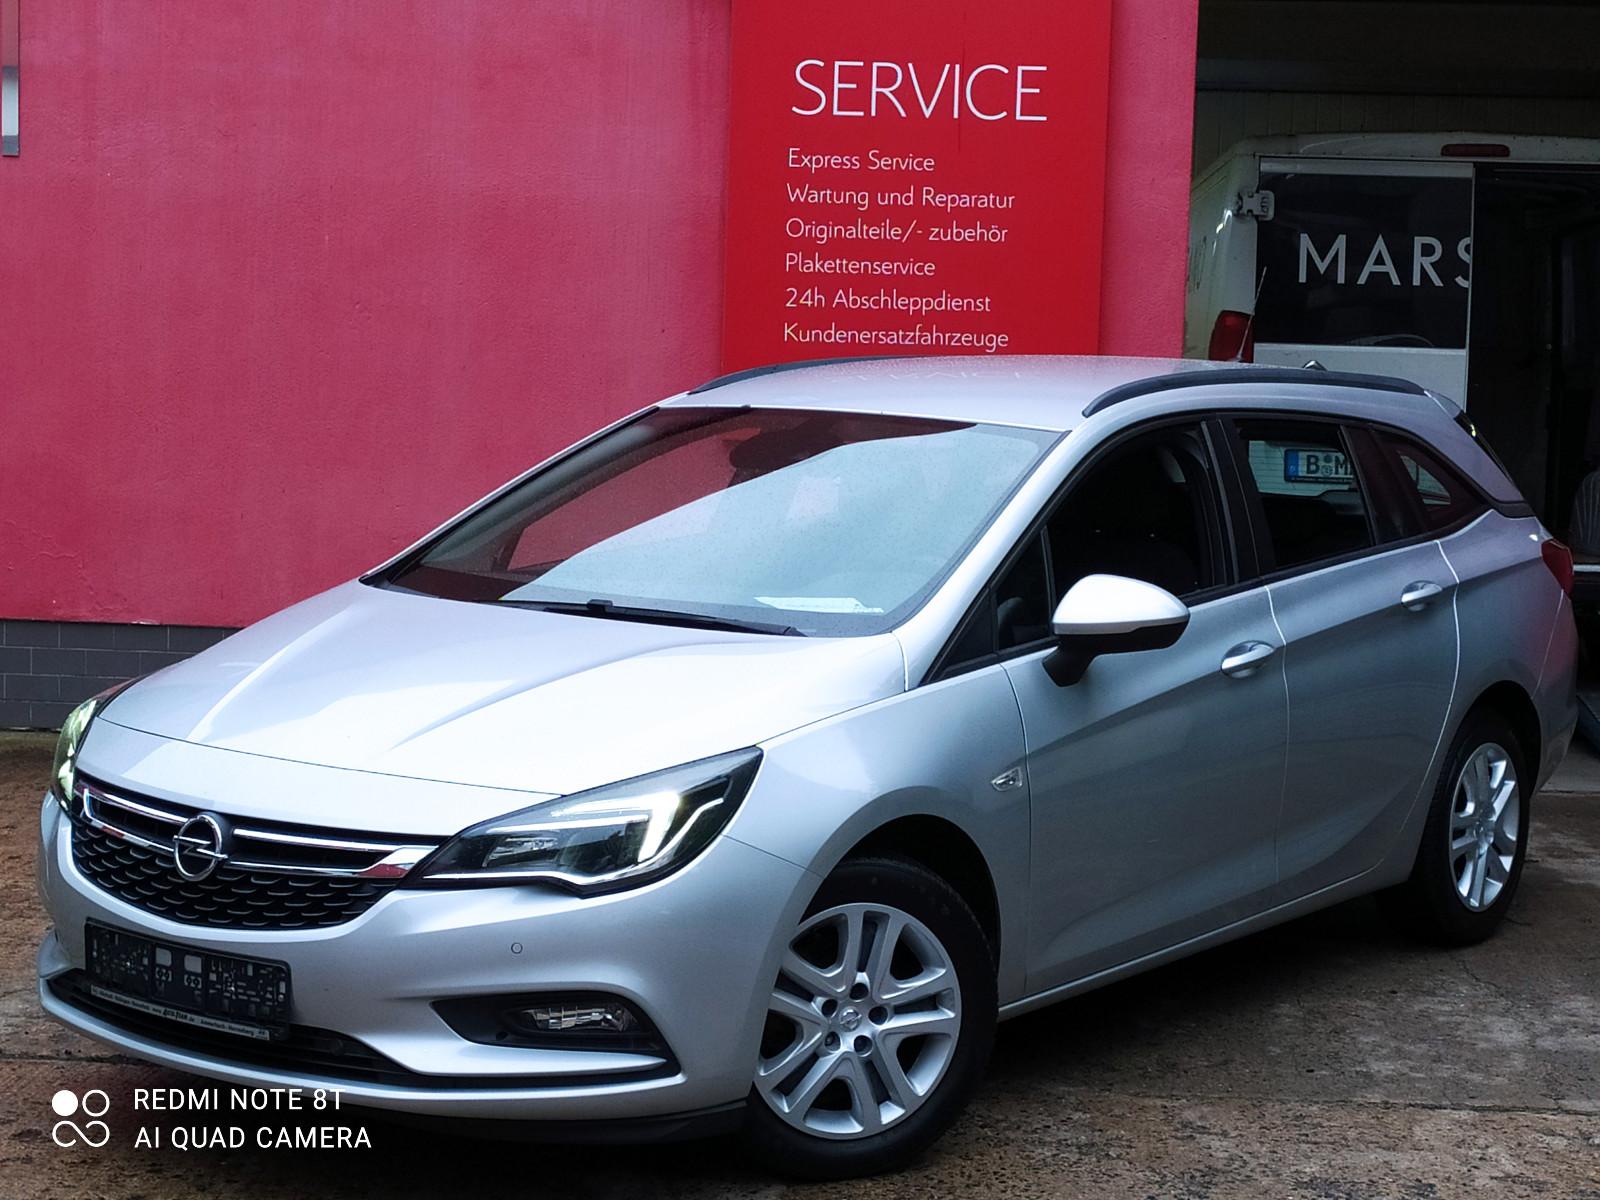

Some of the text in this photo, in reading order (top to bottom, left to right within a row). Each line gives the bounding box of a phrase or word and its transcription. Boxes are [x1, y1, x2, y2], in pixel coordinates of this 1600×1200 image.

[791, 59, 1048, 121] SERVICE
[788, 148, 935, 174] Express Service
[786, 183, 1015, 212] Wartung und Reparatur
[928, 221, 1008, 243] zubehör
[785, 252, 936, 277] Plakettenservice
[785, 287, 991, 315] 24h Abschleppdienst
[784, 322, 1009, 353] Kundenersatzfahrzeuge
